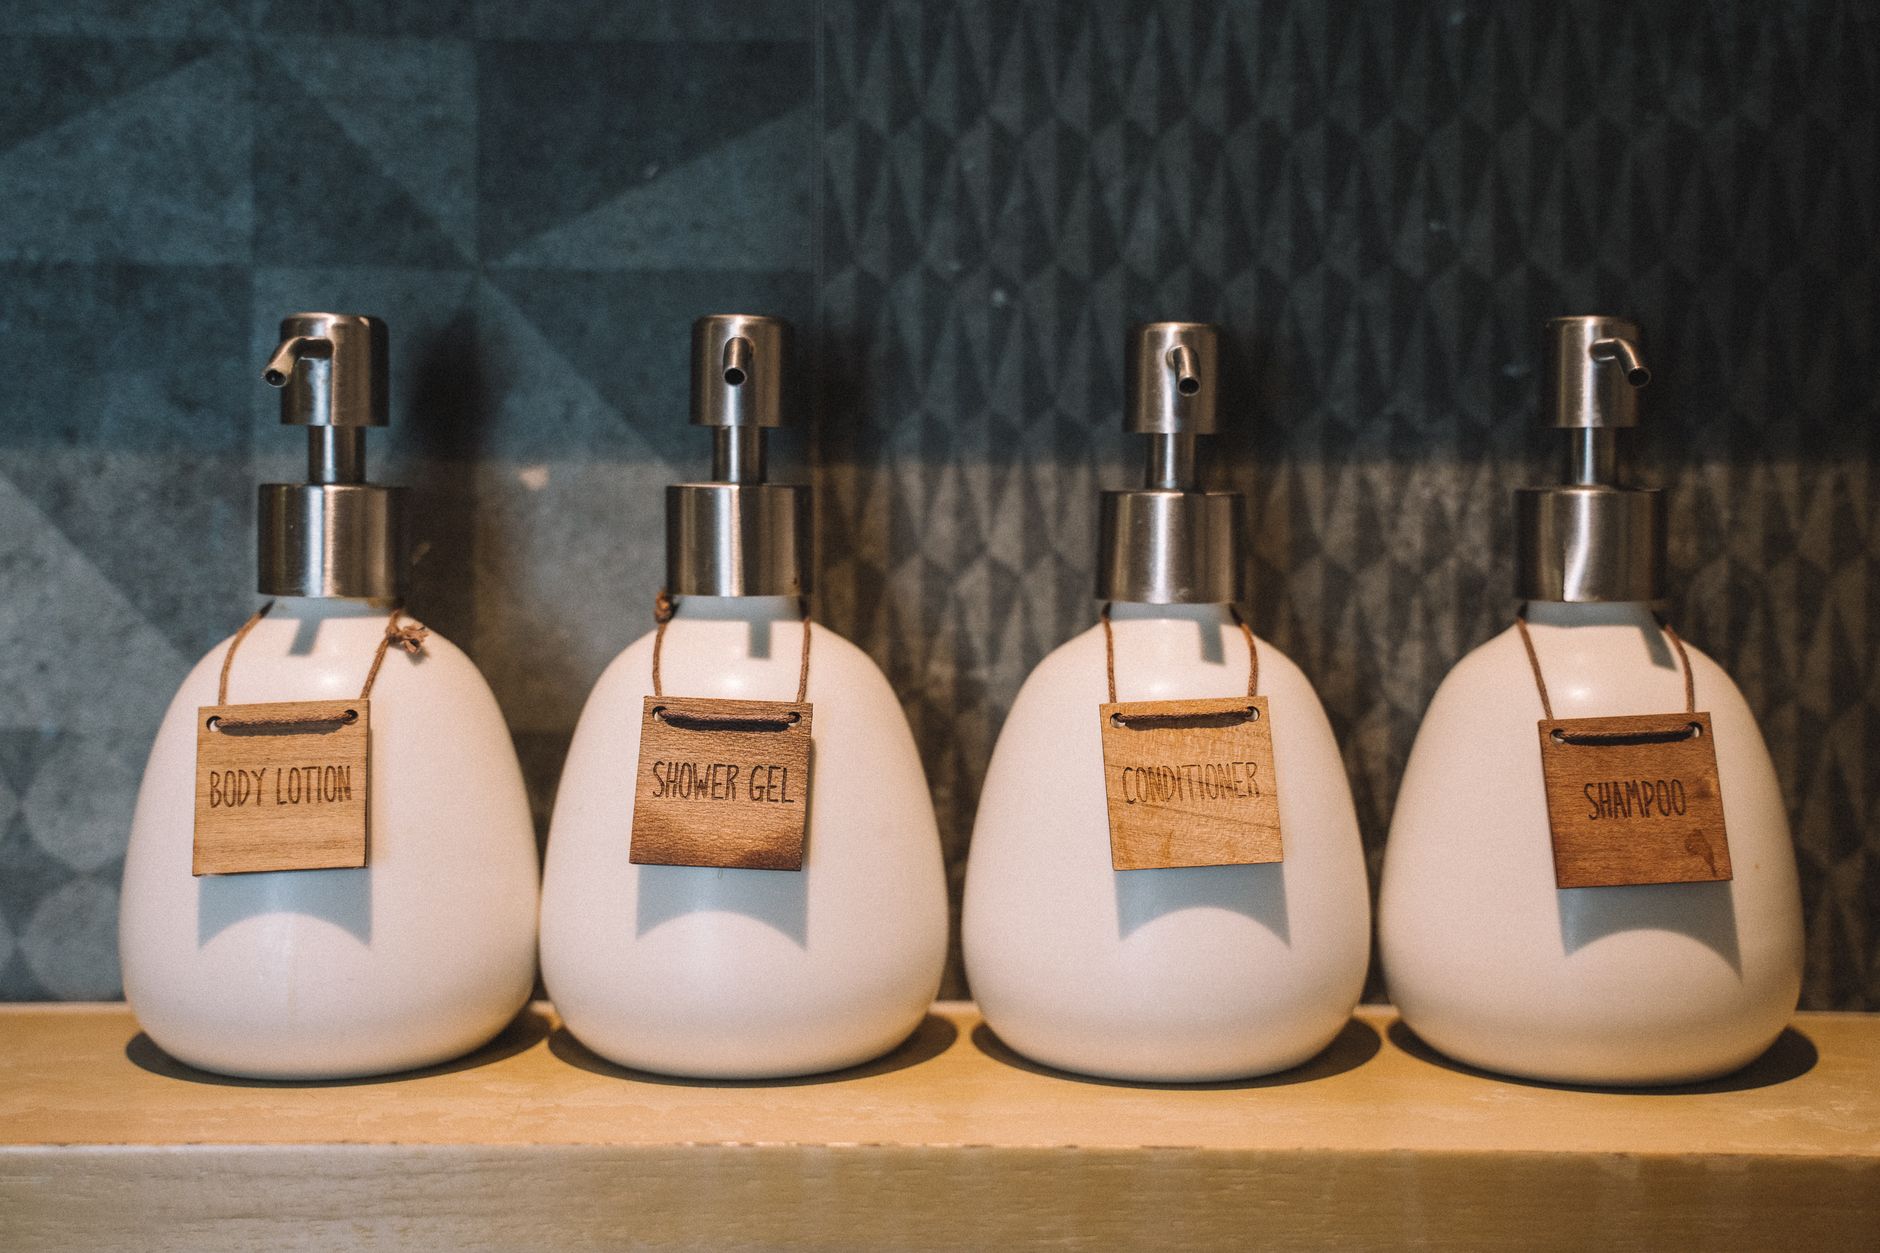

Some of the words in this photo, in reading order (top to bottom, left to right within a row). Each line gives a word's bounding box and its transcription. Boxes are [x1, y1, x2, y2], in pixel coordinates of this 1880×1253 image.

[209, 767, 266, 808] BODY
[276, 765, 352, 805] LOTION
[652, 761, 740, 801] SHOWER
[750, 765, 794, 803] GEL
[1122, 762, 1260, 804] CONDITIONER
[1583, 779, 1687, 820] SHAMPOO
